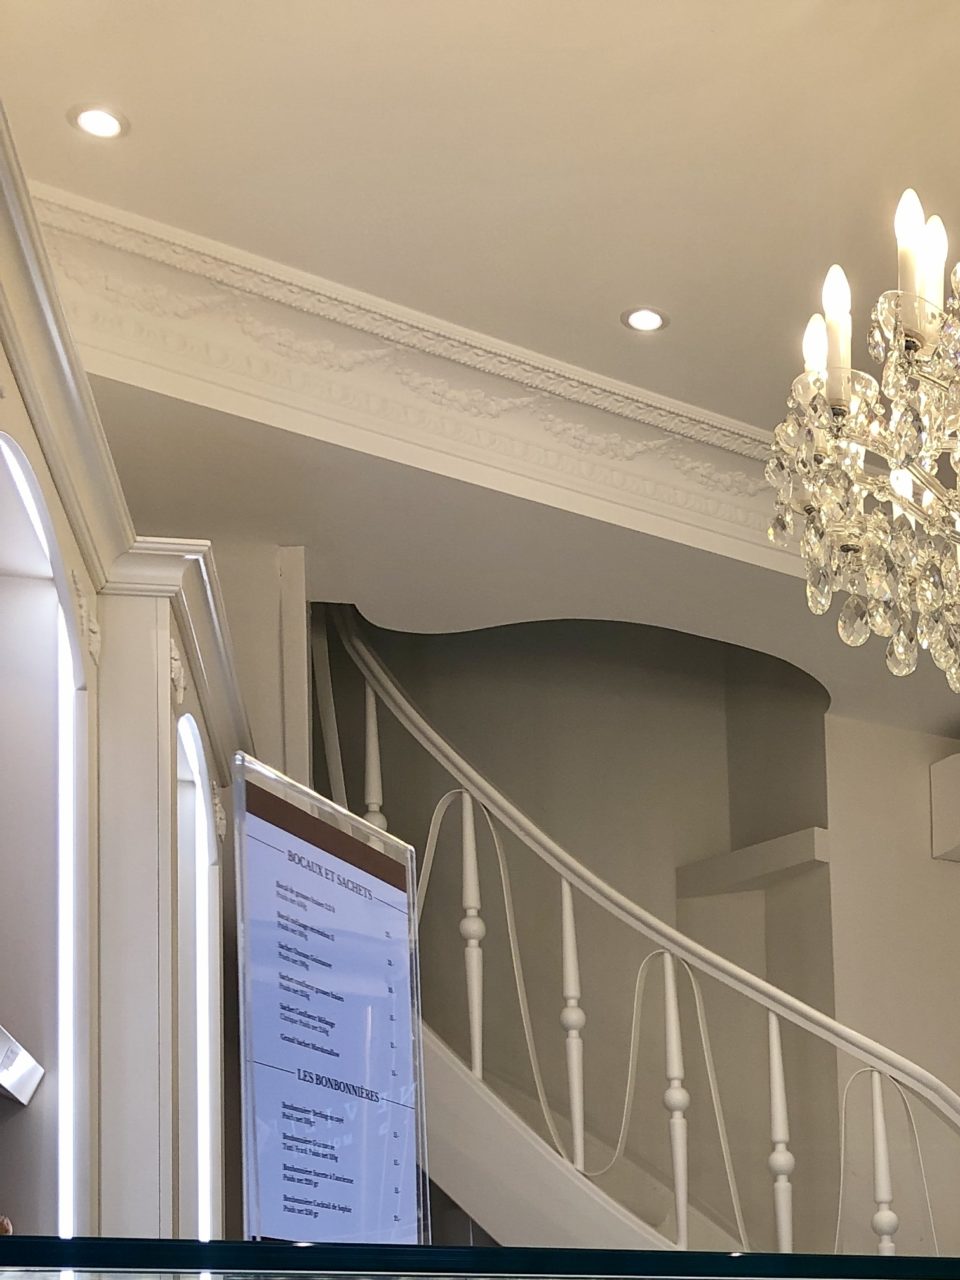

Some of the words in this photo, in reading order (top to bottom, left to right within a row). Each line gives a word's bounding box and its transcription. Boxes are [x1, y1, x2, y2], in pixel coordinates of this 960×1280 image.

[288, 850, 323, 877] BOCAUX
[325, 867, 335, 882] ET
[337, 873, 373, 900] SACHETS
[297, 1068, 314, 1084] LES
